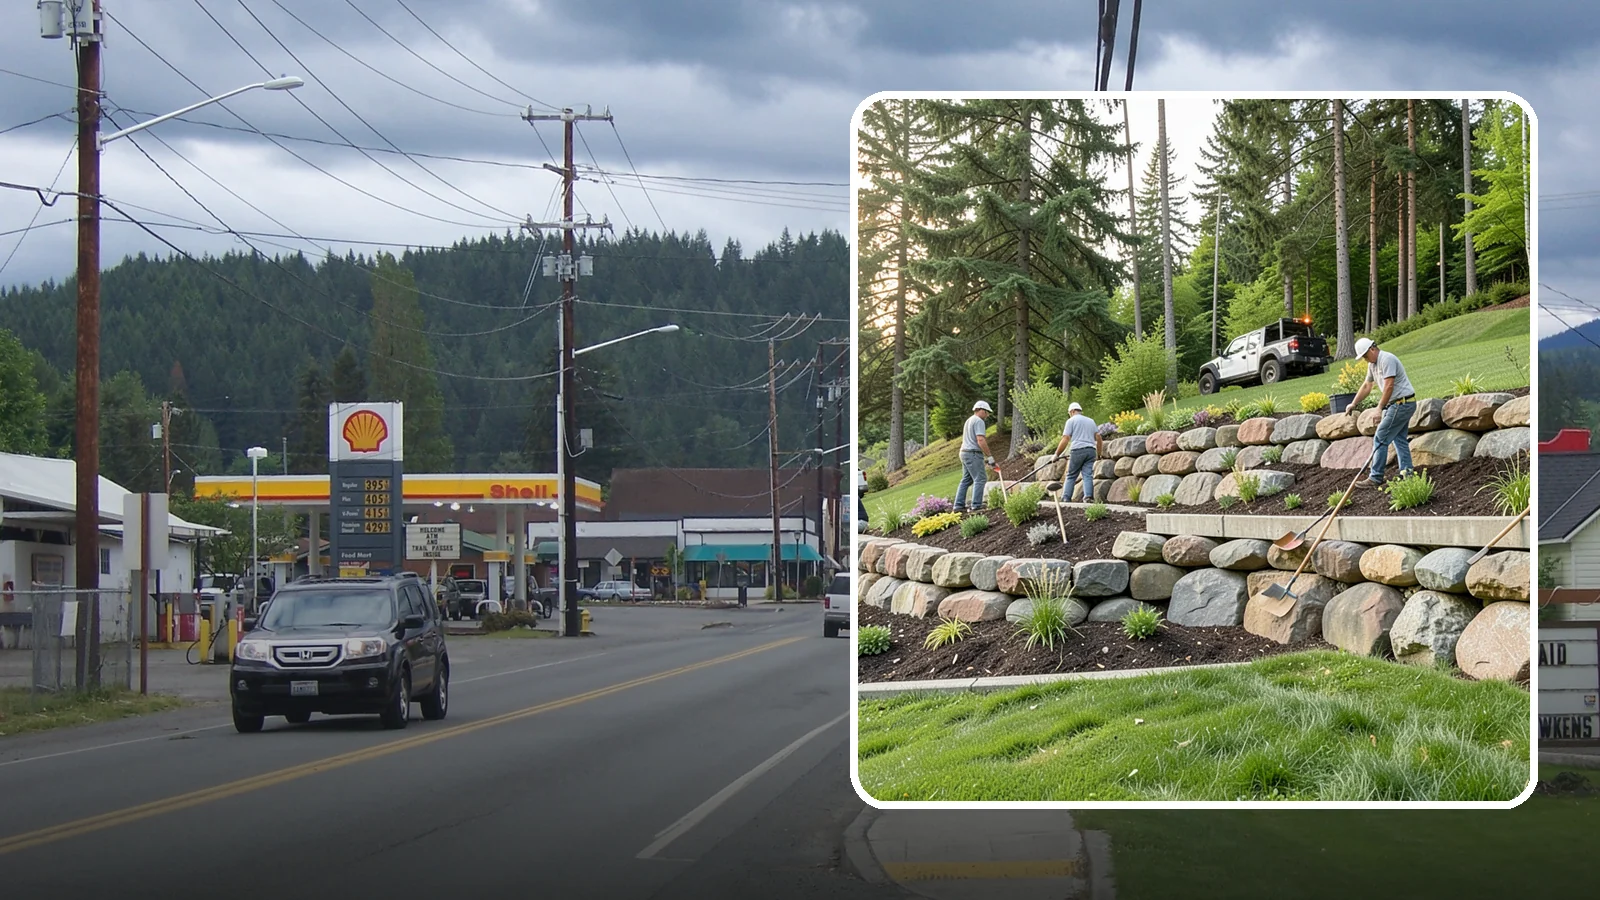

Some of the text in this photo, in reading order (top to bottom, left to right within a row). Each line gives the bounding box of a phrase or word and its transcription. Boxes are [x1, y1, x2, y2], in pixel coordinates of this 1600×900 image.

[365, 480, 384, 490] 395
[490, 484, 547, 498] Shell
[365, 494, 384, 504] 405
[365, 508, 384, 518] 415
[365, 522, 384, 533] 429
